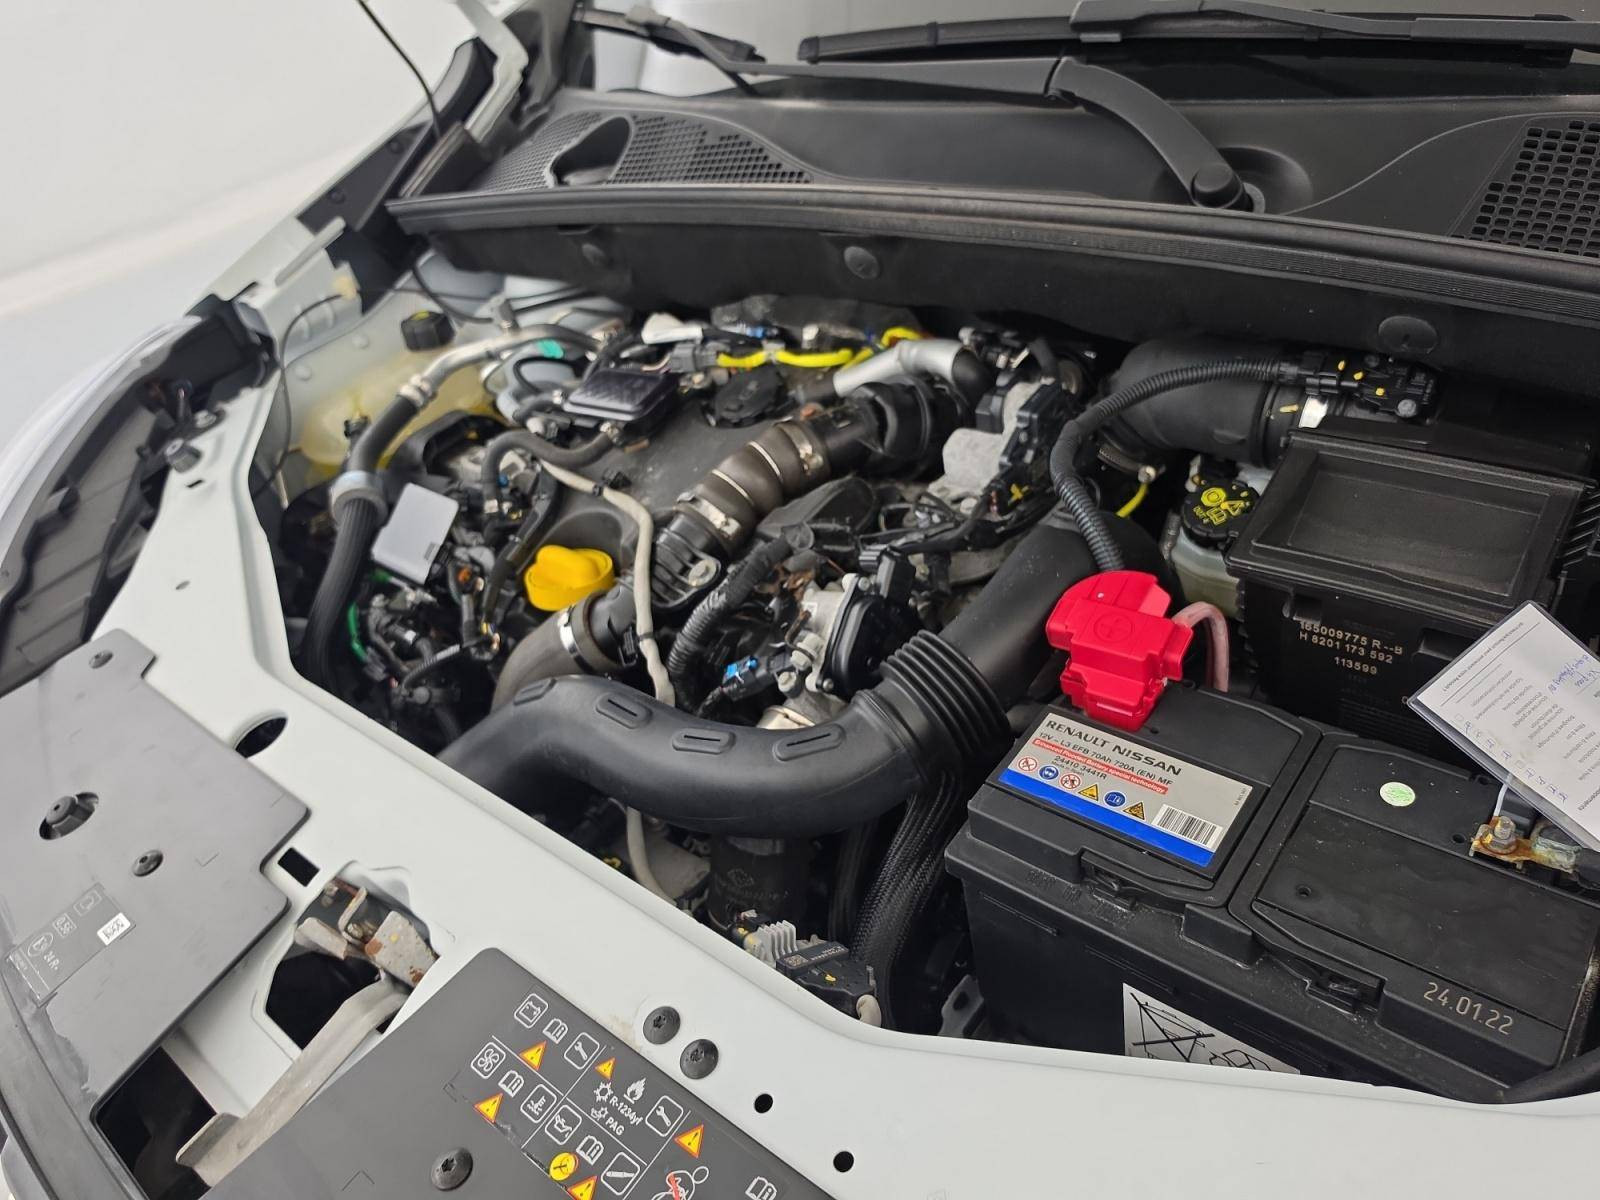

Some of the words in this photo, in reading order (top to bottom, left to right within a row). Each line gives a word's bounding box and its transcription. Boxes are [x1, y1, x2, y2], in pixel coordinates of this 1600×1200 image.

[1299, 631, 1308, 641] H
[1311, 634, 1340, 650] 8201
[1344, 643, 1365, 656] 173
[1369, 650, 1393, 664] 592
[1334, 656, 1378, 675] 113599
[1046, 720, 1110, 748] RENAULT
[1112, 744, 1182, 776] NISSAN
[1072, 745, 1090, 754] EFB
[1091, 751, 1112, 764] 70Ah
[1114, 760, 1135, 772] 720A
[1136, 768, 1156, 780] (EN)
[1054, 756, 1080, 768] 24410
[1080, 766, 1107, 780] 3441R
[1423, 981, 1514, 1036] 24.01.22
[605, 1116, 625, 1136] PAG
[610, 1095, 644, 1126] R-1234yf
